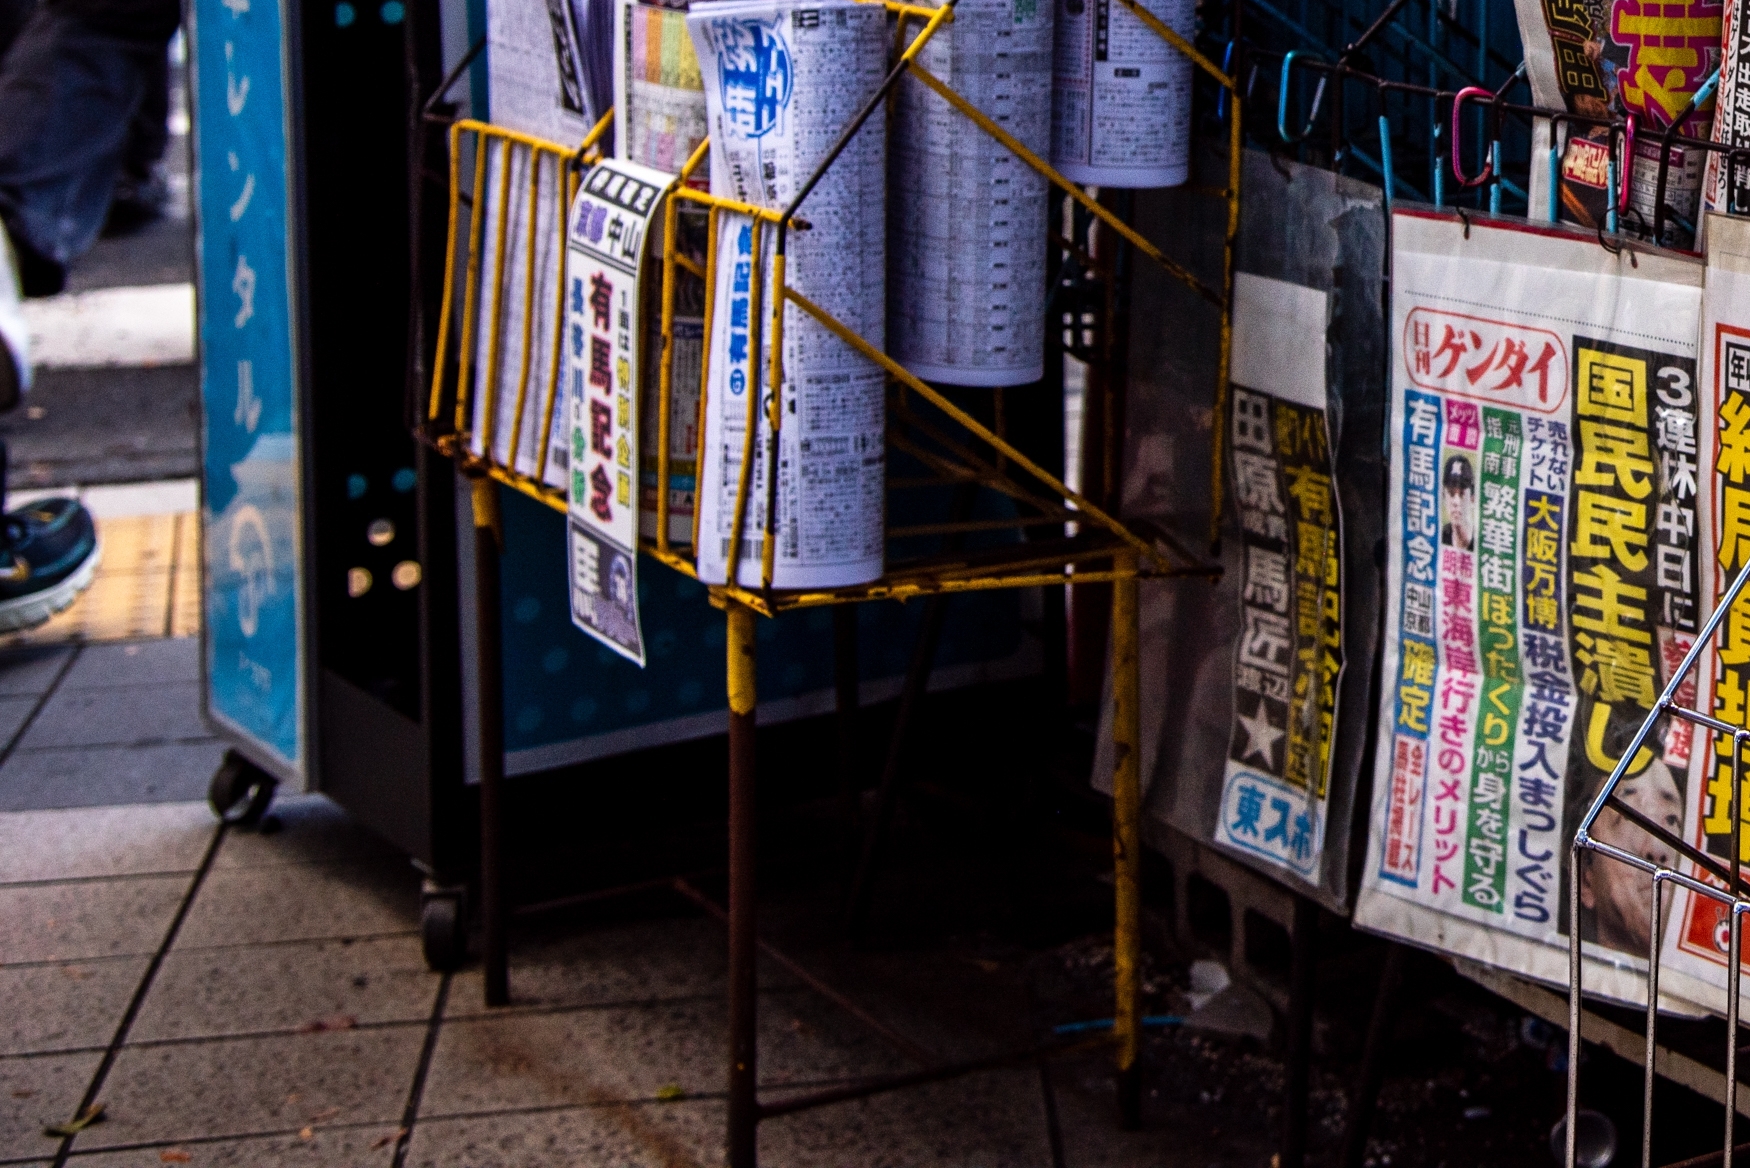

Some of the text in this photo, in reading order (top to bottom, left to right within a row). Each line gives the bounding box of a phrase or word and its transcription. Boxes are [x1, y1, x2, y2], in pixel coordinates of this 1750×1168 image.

[727, 223, 753, 363] 有馬記念
[588, 270, 613, 524] 有馬記念
[1413, 319, 1558, 404] 日刊 ゲンダイ
[1230, 389, 1284, 517] 田原
[1405, 397, 1439, 583] 有馬記念
[1526, 416, 1546, 490] チケット
[1548, 419, 1568, 493] 売れない
[1570, 346, 1656, 776] 国民民主潰し
[1398, 639, 1435, 732] 確定
[1513, 495, 1569, 926] 大阪万博 税金投入まっしぐら
[1230, 783, 1316, 865] 東スポ
